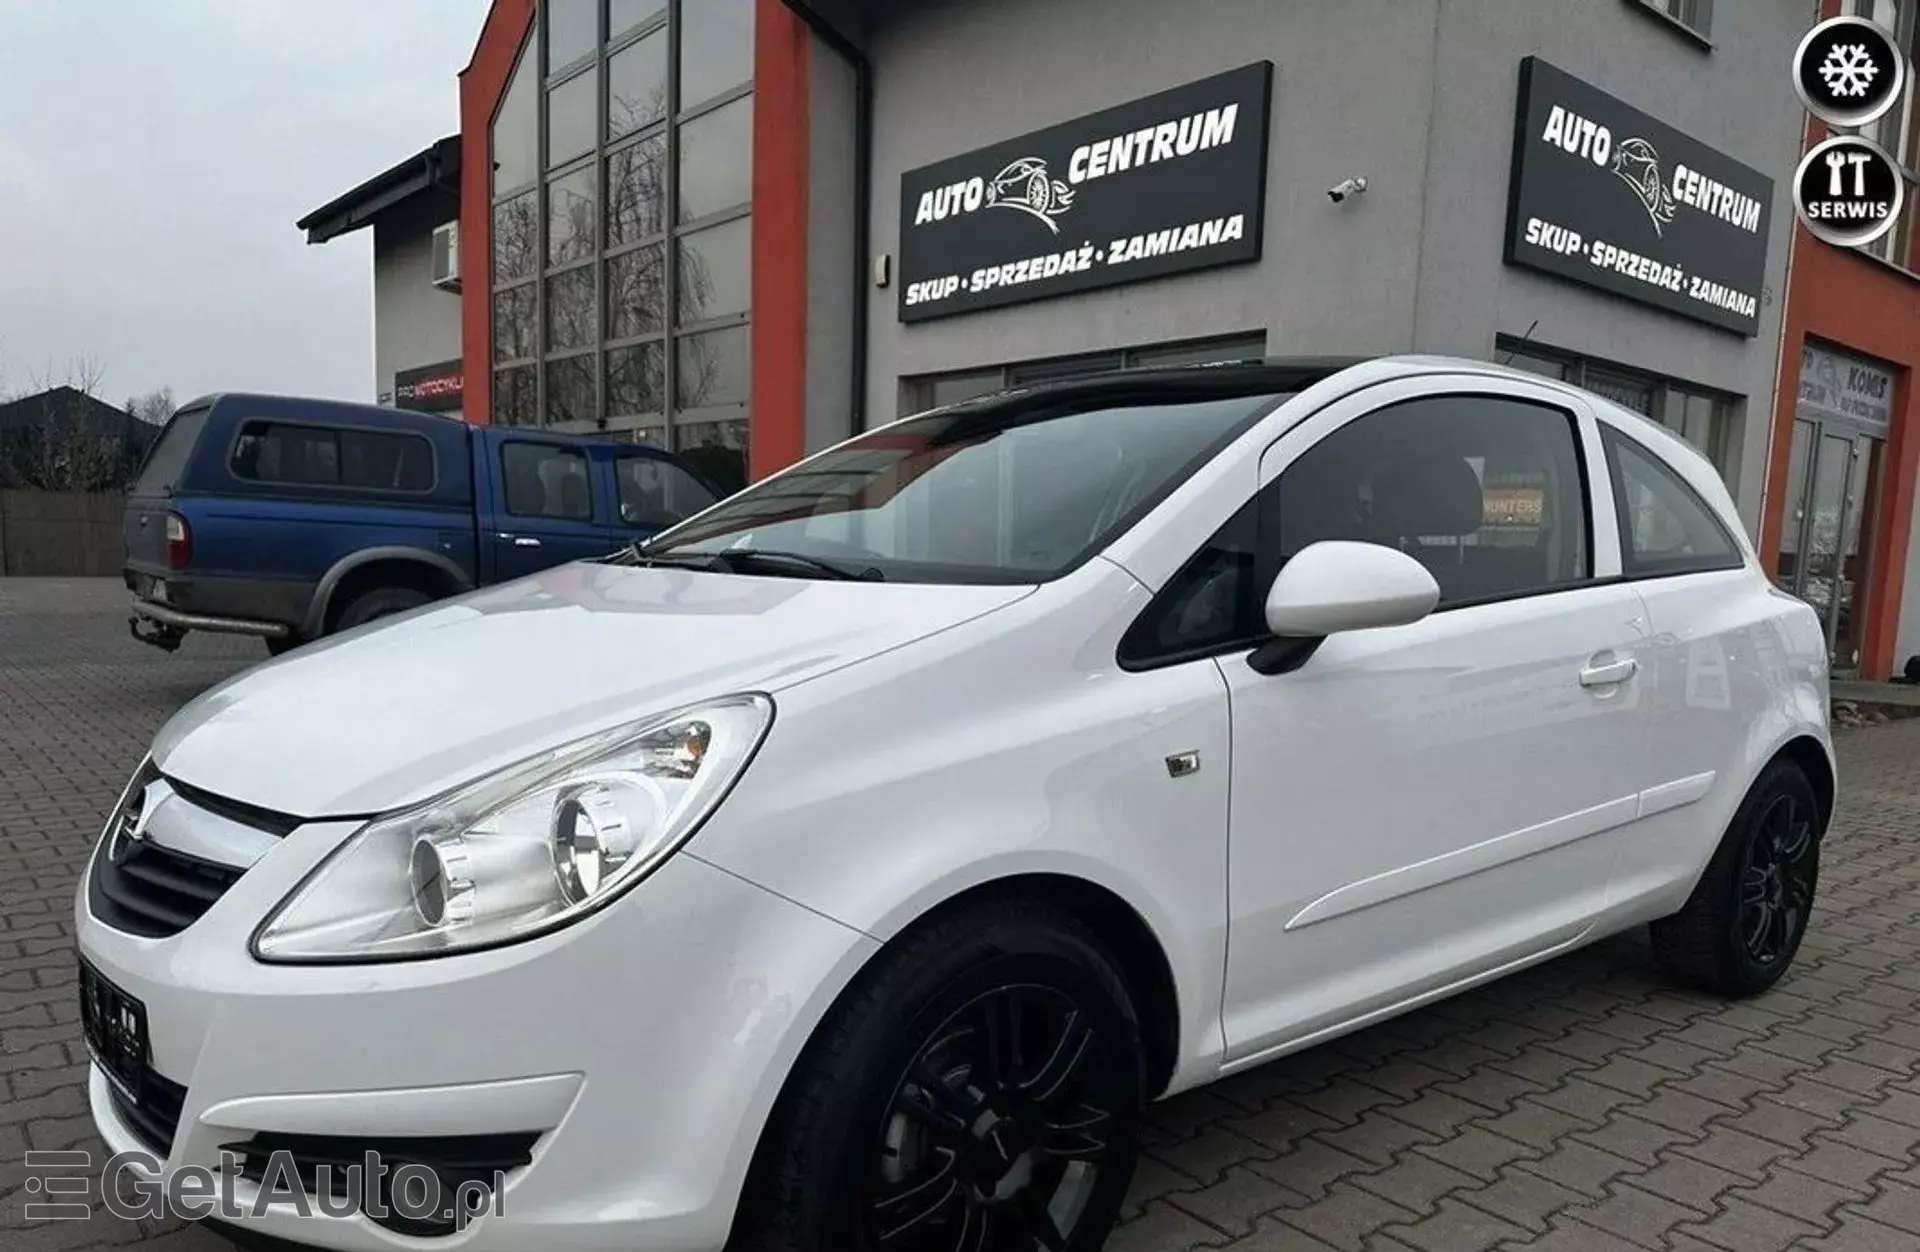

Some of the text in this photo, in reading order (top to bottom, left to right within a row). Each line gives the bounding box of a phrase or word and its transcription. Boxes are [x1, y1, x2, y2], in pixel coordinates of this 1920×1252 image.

[914, 102, 1239, 226] AUTO CENTRUM
[1542, 104, 1761, 234] AUTO CENTRUM
[904, 214, 1245, 306] SKUP SPRZEDAŻ ZAMIANA
[1525, 217, 1757, 319] SKUP SPRZEDAŻ ZAMIANA
